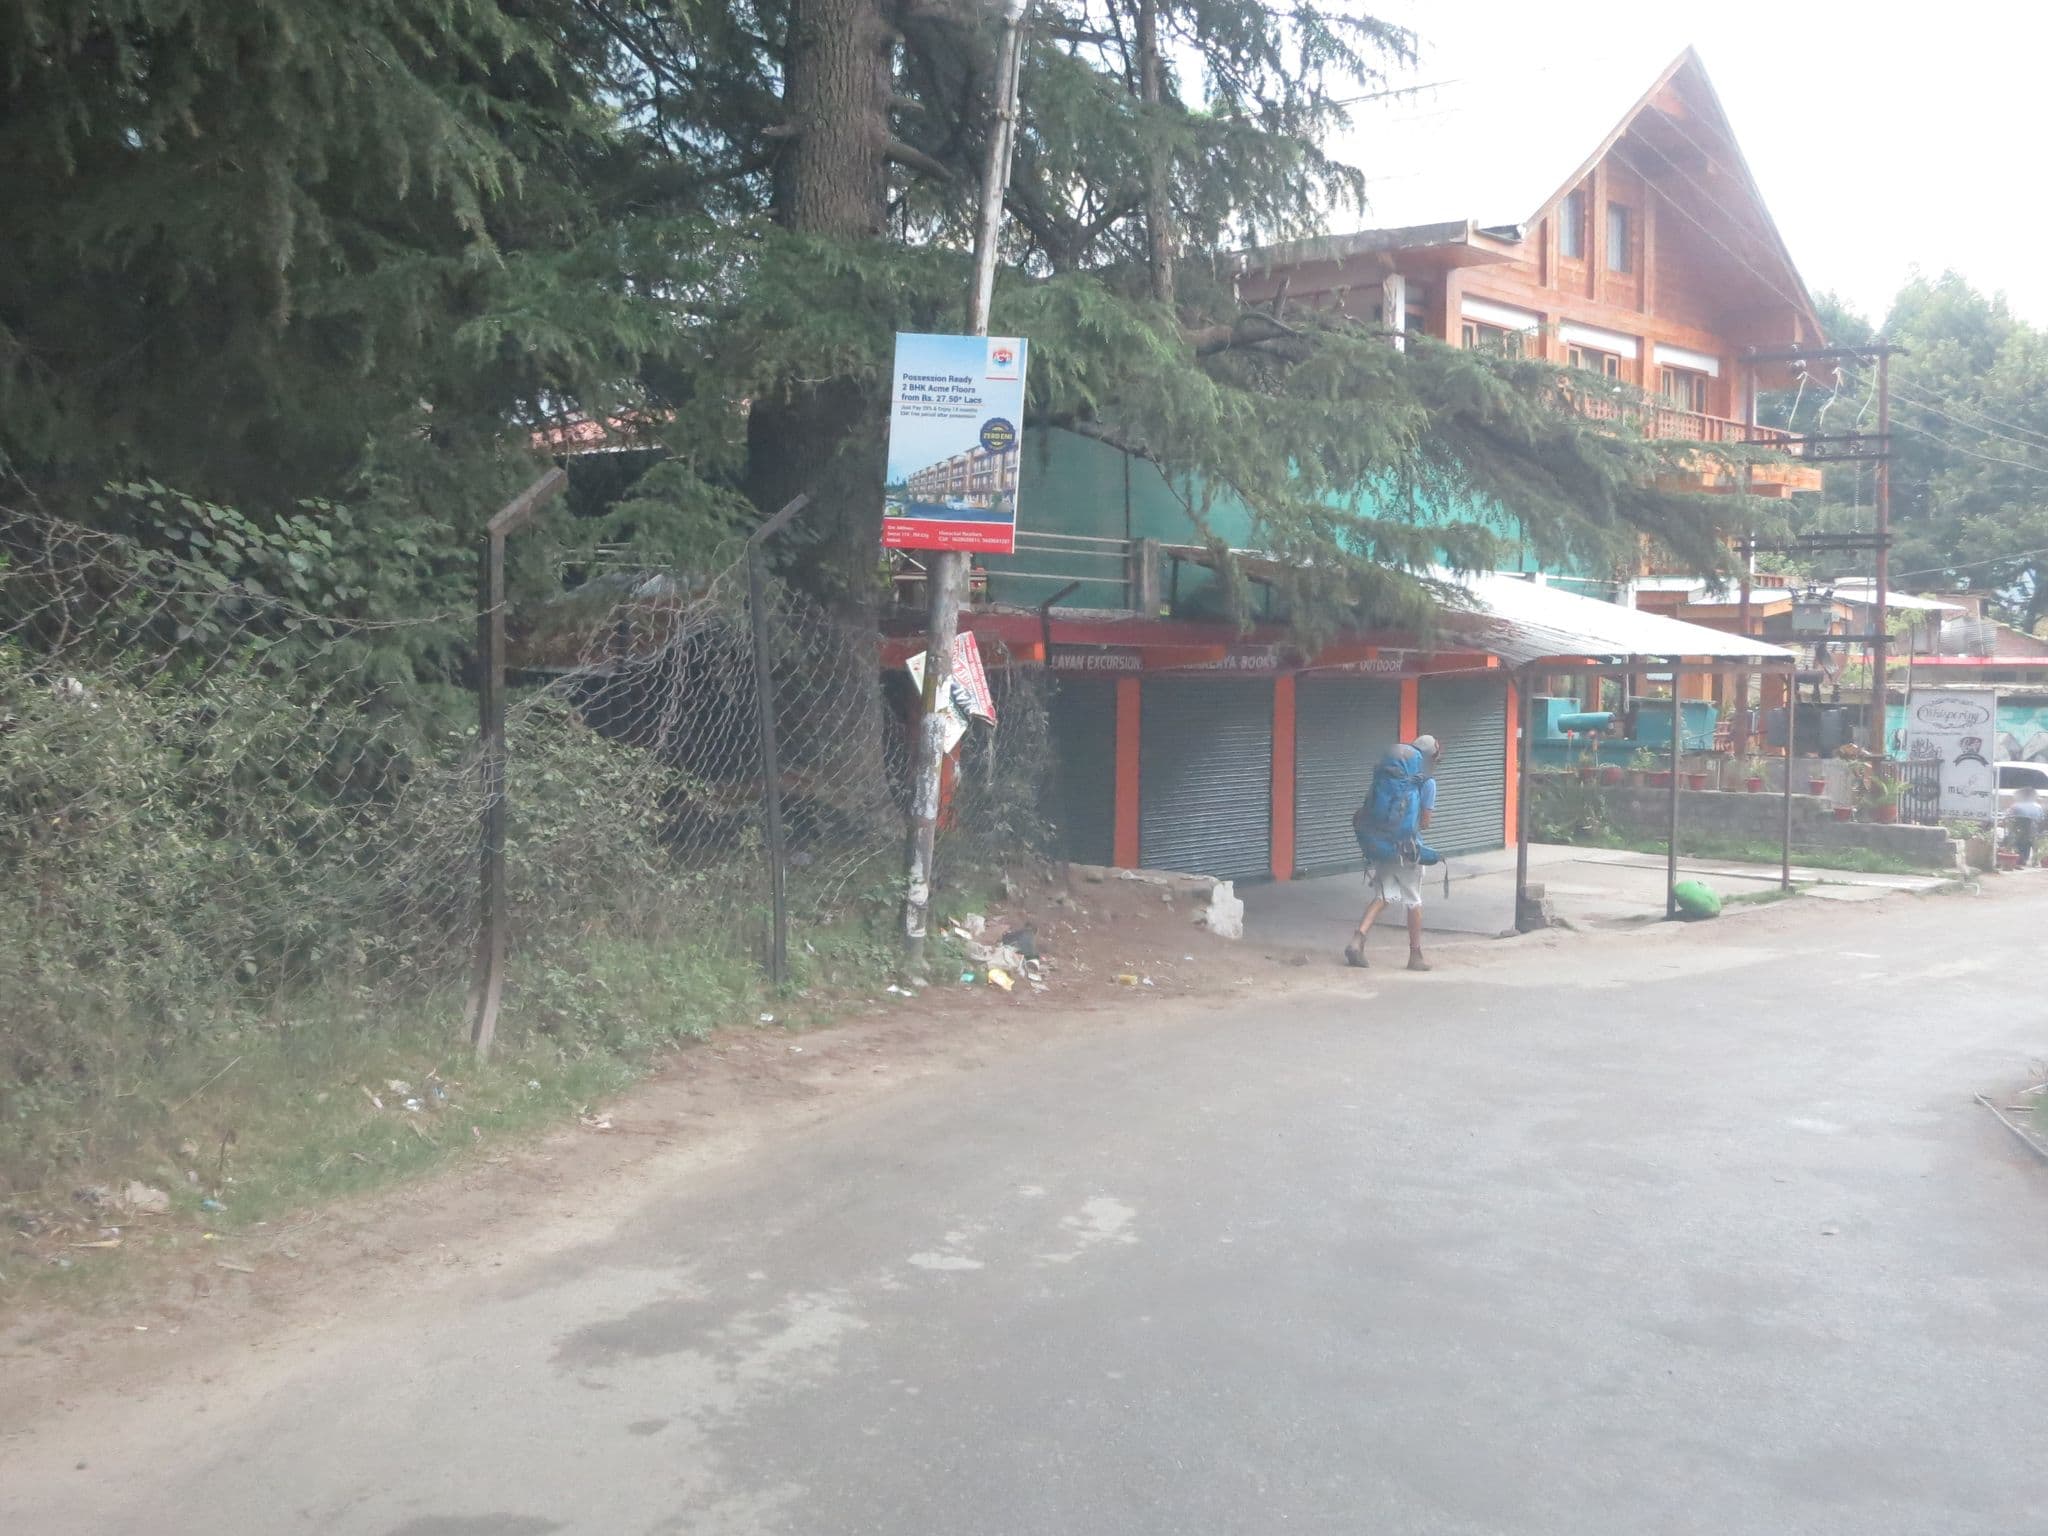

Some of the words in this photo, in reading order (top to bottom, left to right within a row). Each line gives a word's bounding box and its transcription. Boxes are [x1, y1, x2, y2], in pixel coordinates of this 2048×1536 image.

[903, 373, 947, 382] Possession
[948, 375, 973, 384] Ready
[902, 393, 919, 401] from
[921, 394, 934, 402] Rs.
[1240, 655, 1278, 670] BOOKS
